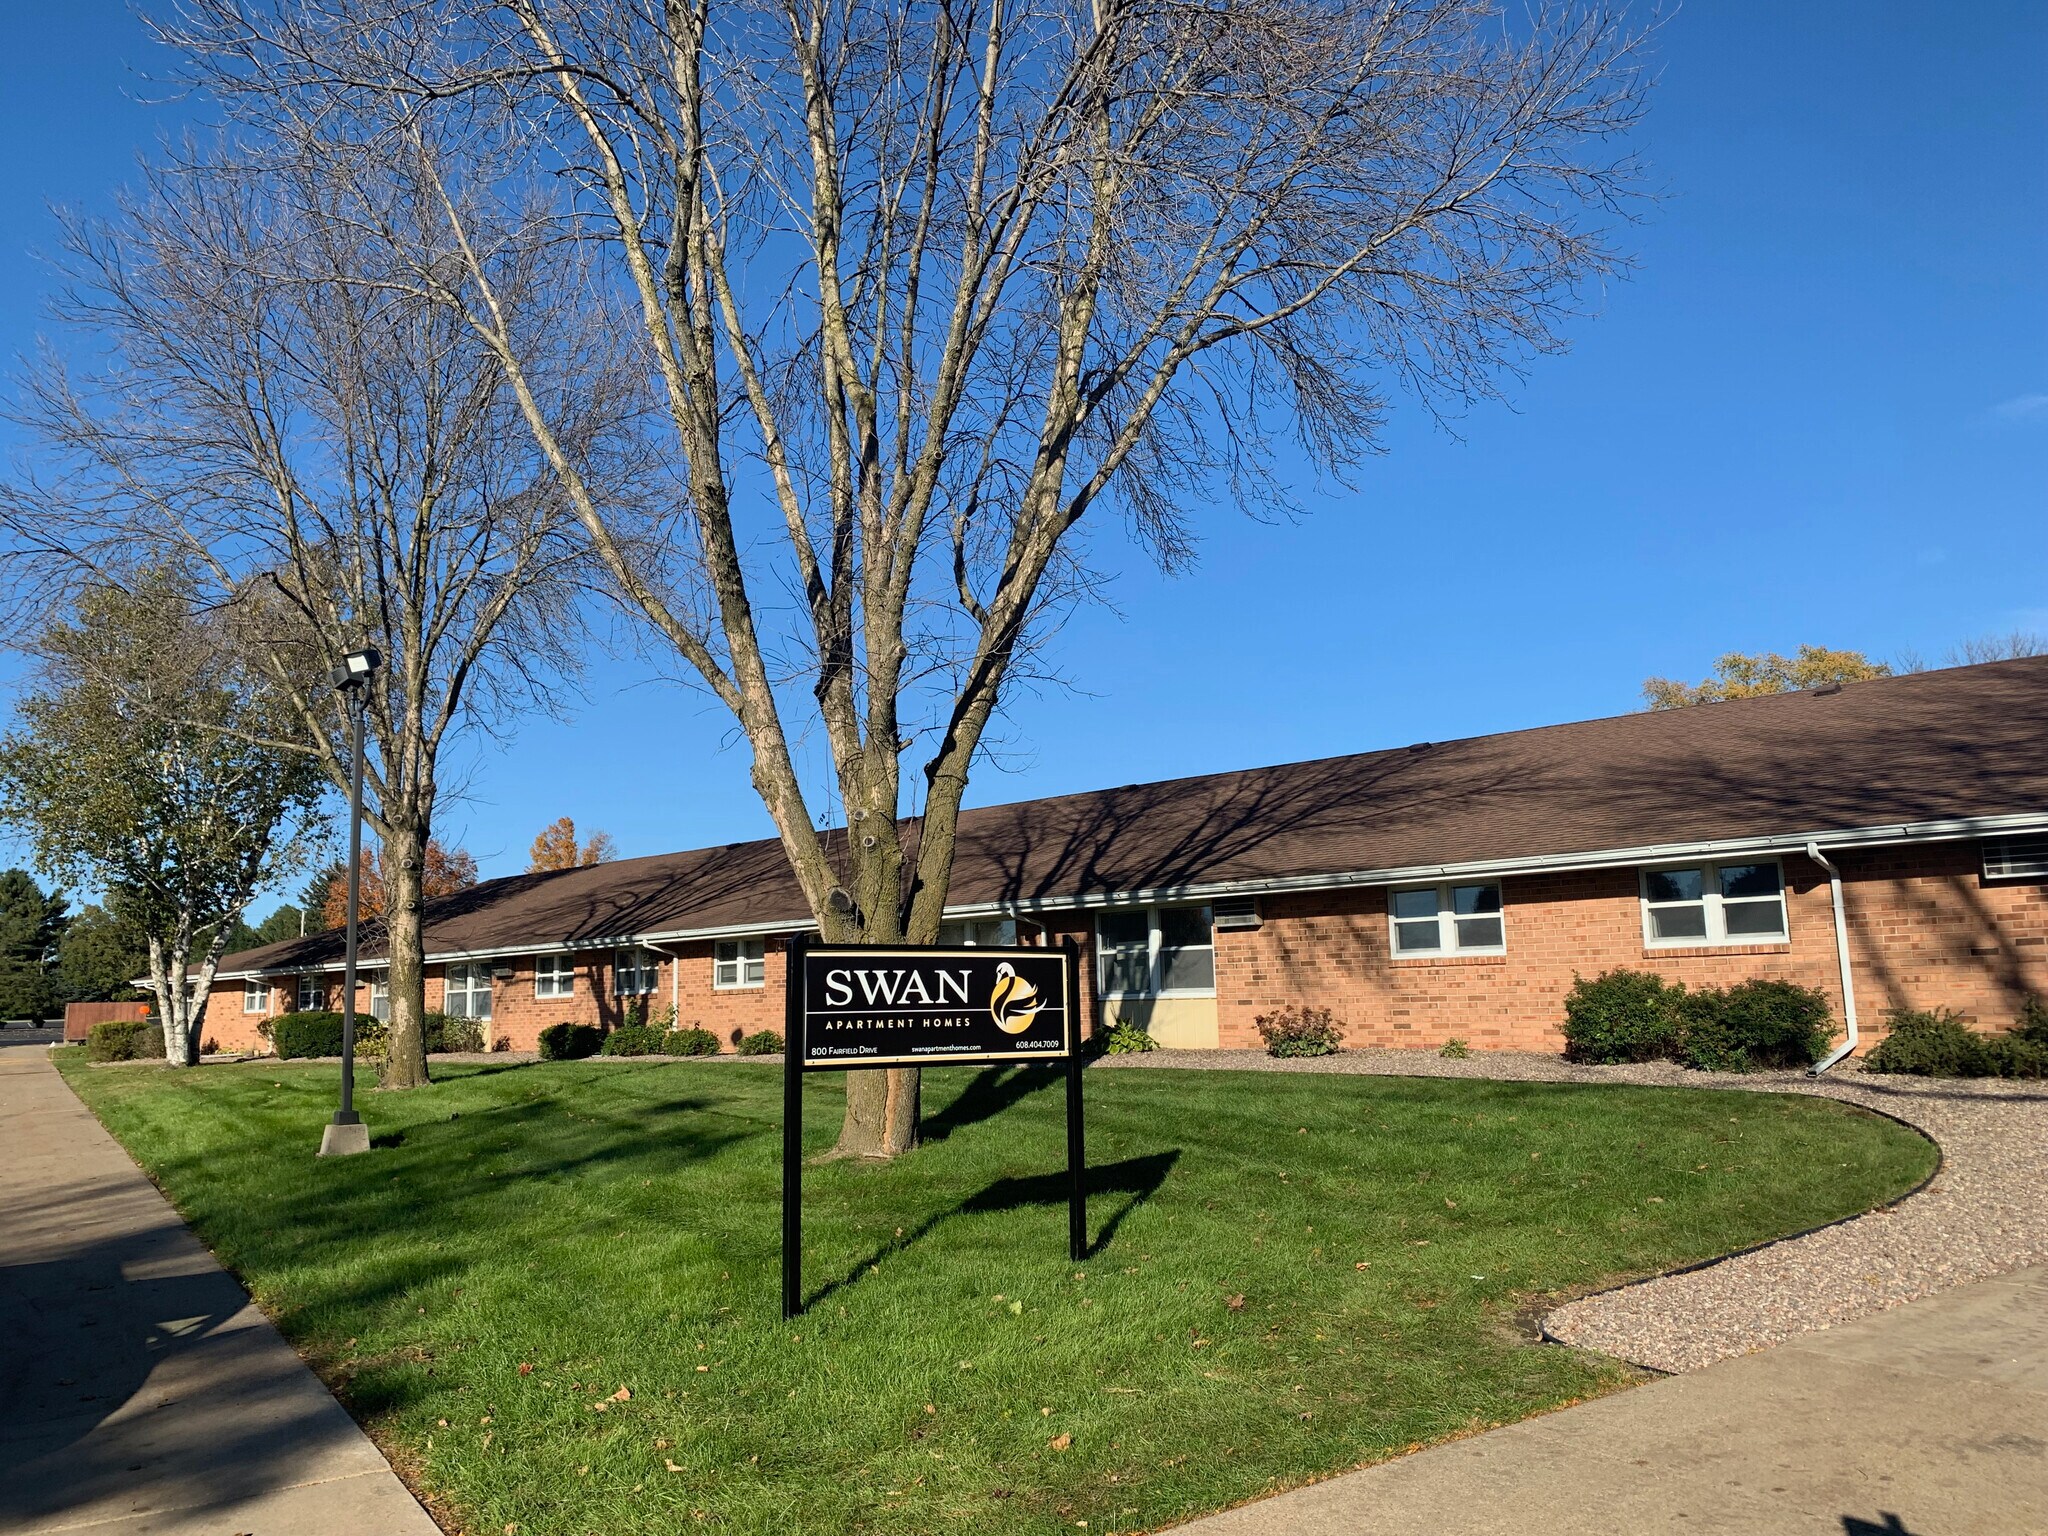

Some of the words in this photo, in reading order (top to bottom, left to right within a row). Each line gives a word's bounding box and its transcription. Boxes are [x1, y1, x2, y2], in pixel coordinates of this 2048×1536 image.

[825, 969, 972, 1006] SWAN
[825, 1018, 914, 1030] APARTMENT
[923, 1017, 971, 1028] HOMES
[911, 1043, 982, 1054] swanapartmenthomes.com
[1015, 1040, 1059, 1049] 608.404.7009
[811, 1047, 827, 1056] 800
[859, 1045, 878, 1054] DRIVE
